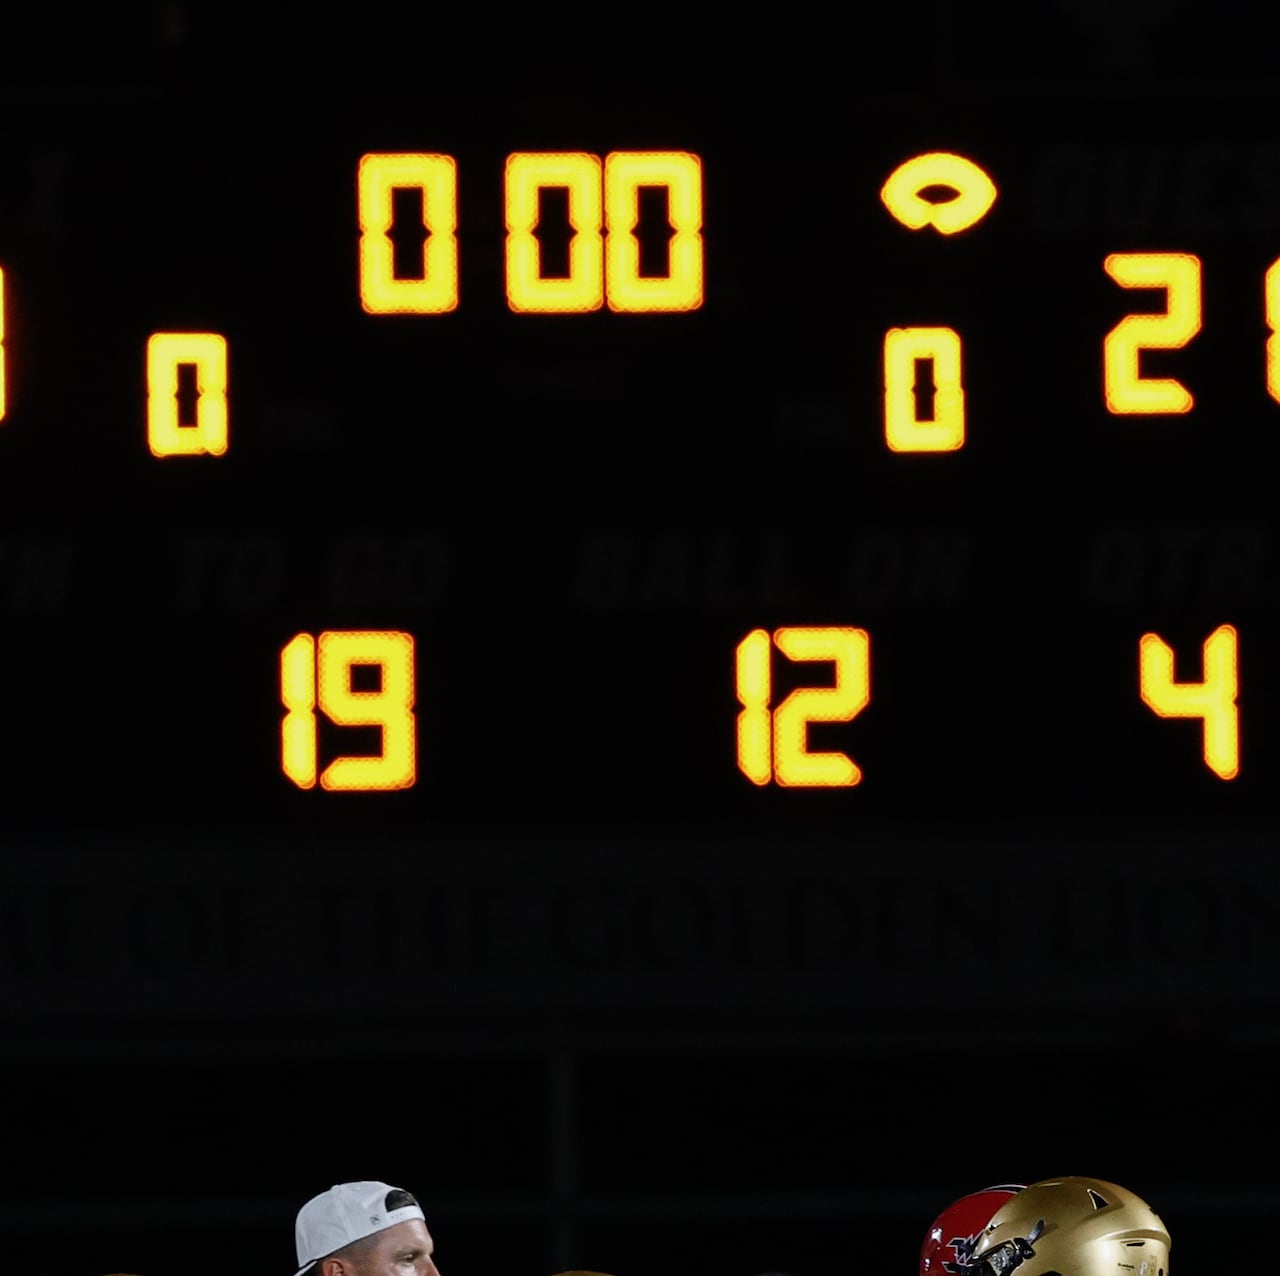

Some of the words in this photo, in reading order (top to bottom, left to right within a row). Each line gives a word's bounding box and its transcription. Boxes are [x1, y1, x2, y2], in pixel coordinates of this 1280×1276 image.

[147, 332, 230, 458] 0
[884, 327, 966, 453] 0
[280, 630, 417, 792] 19
[735, 626, 871, 788] 12
[1139, 623, 1240, 781] 4
